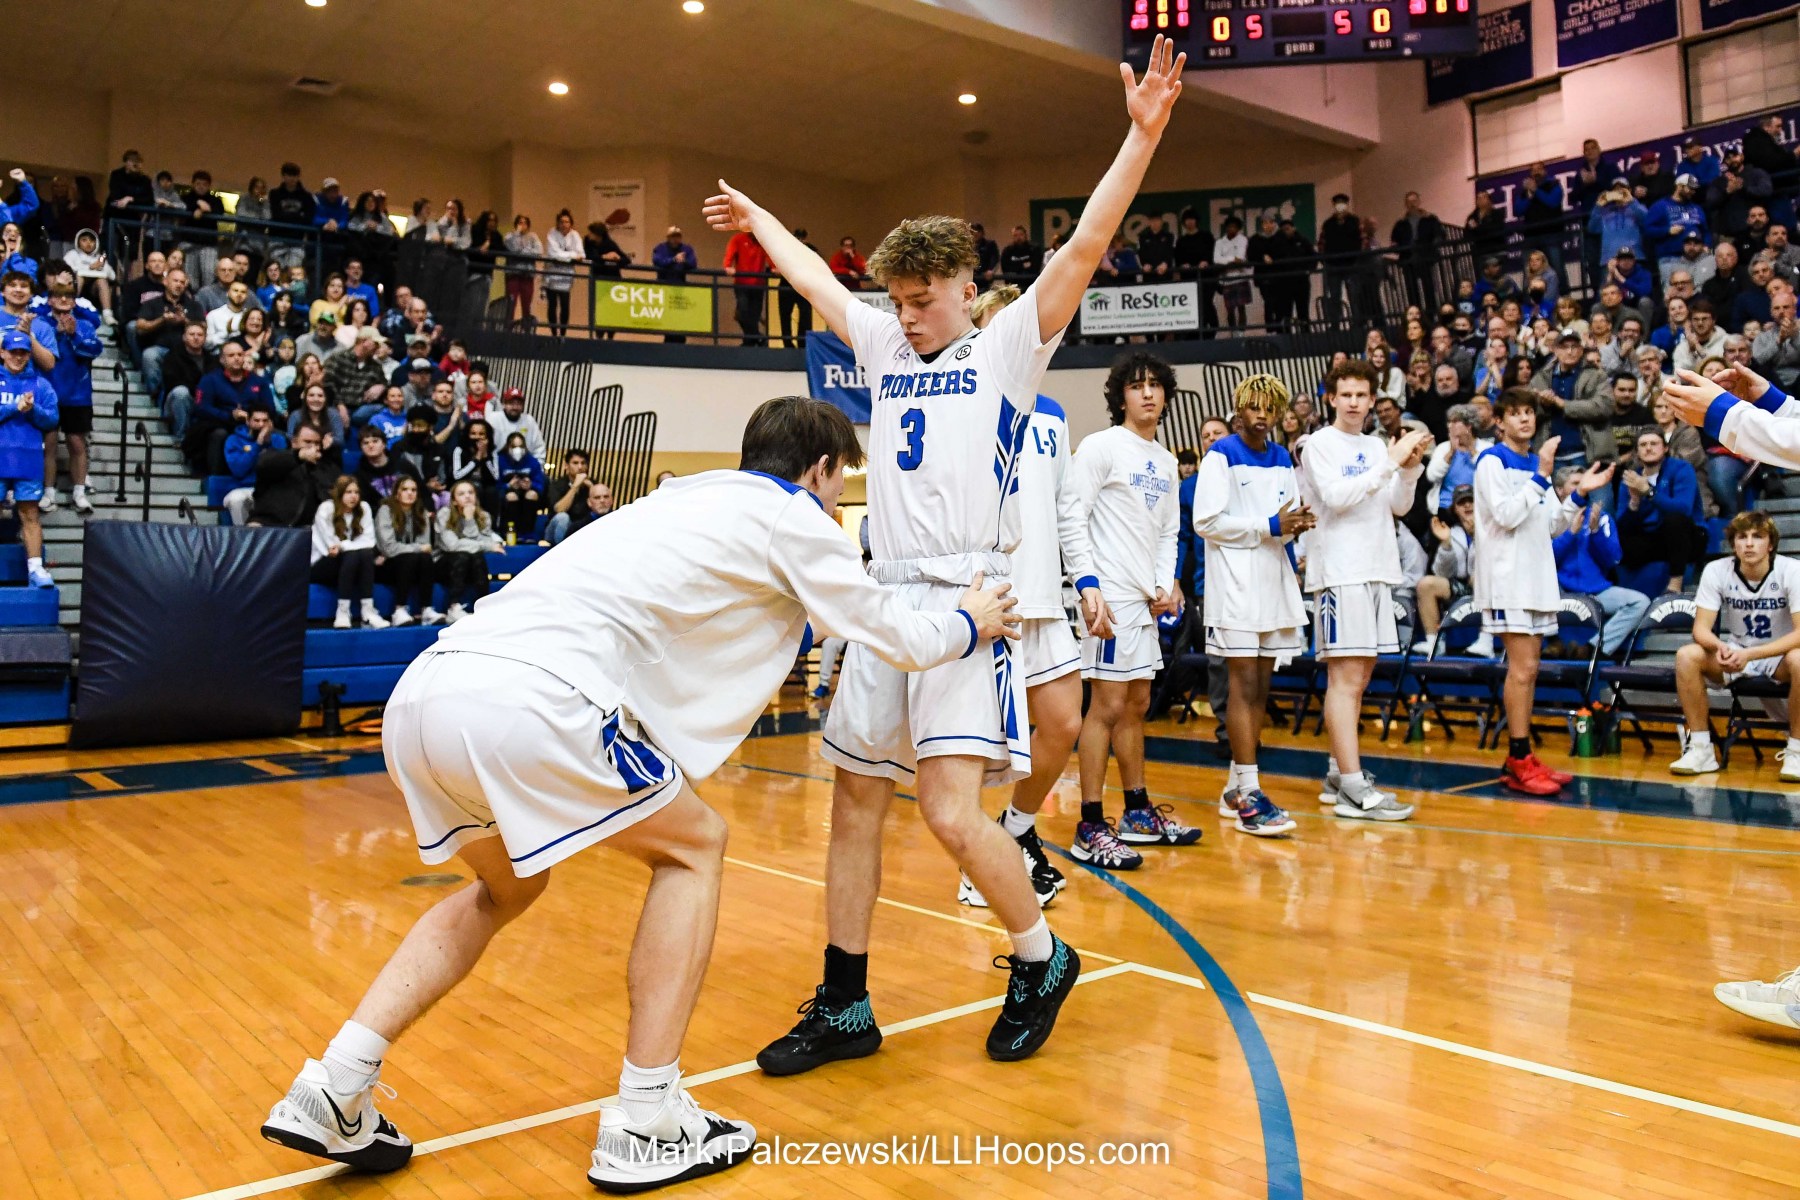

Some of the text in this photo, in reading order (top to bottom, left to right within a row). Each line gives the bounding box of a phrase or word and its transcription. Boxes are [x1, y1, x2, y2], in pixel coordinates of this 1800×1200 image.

[1213, 16, 1230, 42] 0
[1372, 8, 1391, 33] 0
[610, 285, 664, 305] GKH
[1121, 292, 1188, 310] ReStore
[630, 305, 664, 320] LAW
[878, 368, 977, 401] PIONEERS
[897, 408, 926, 471] 3
[1032, 426, 1057, 458] L-S
[1725, 597, 1787, 610] PIONEERS
[1743, 614, 1772, 638] 12
